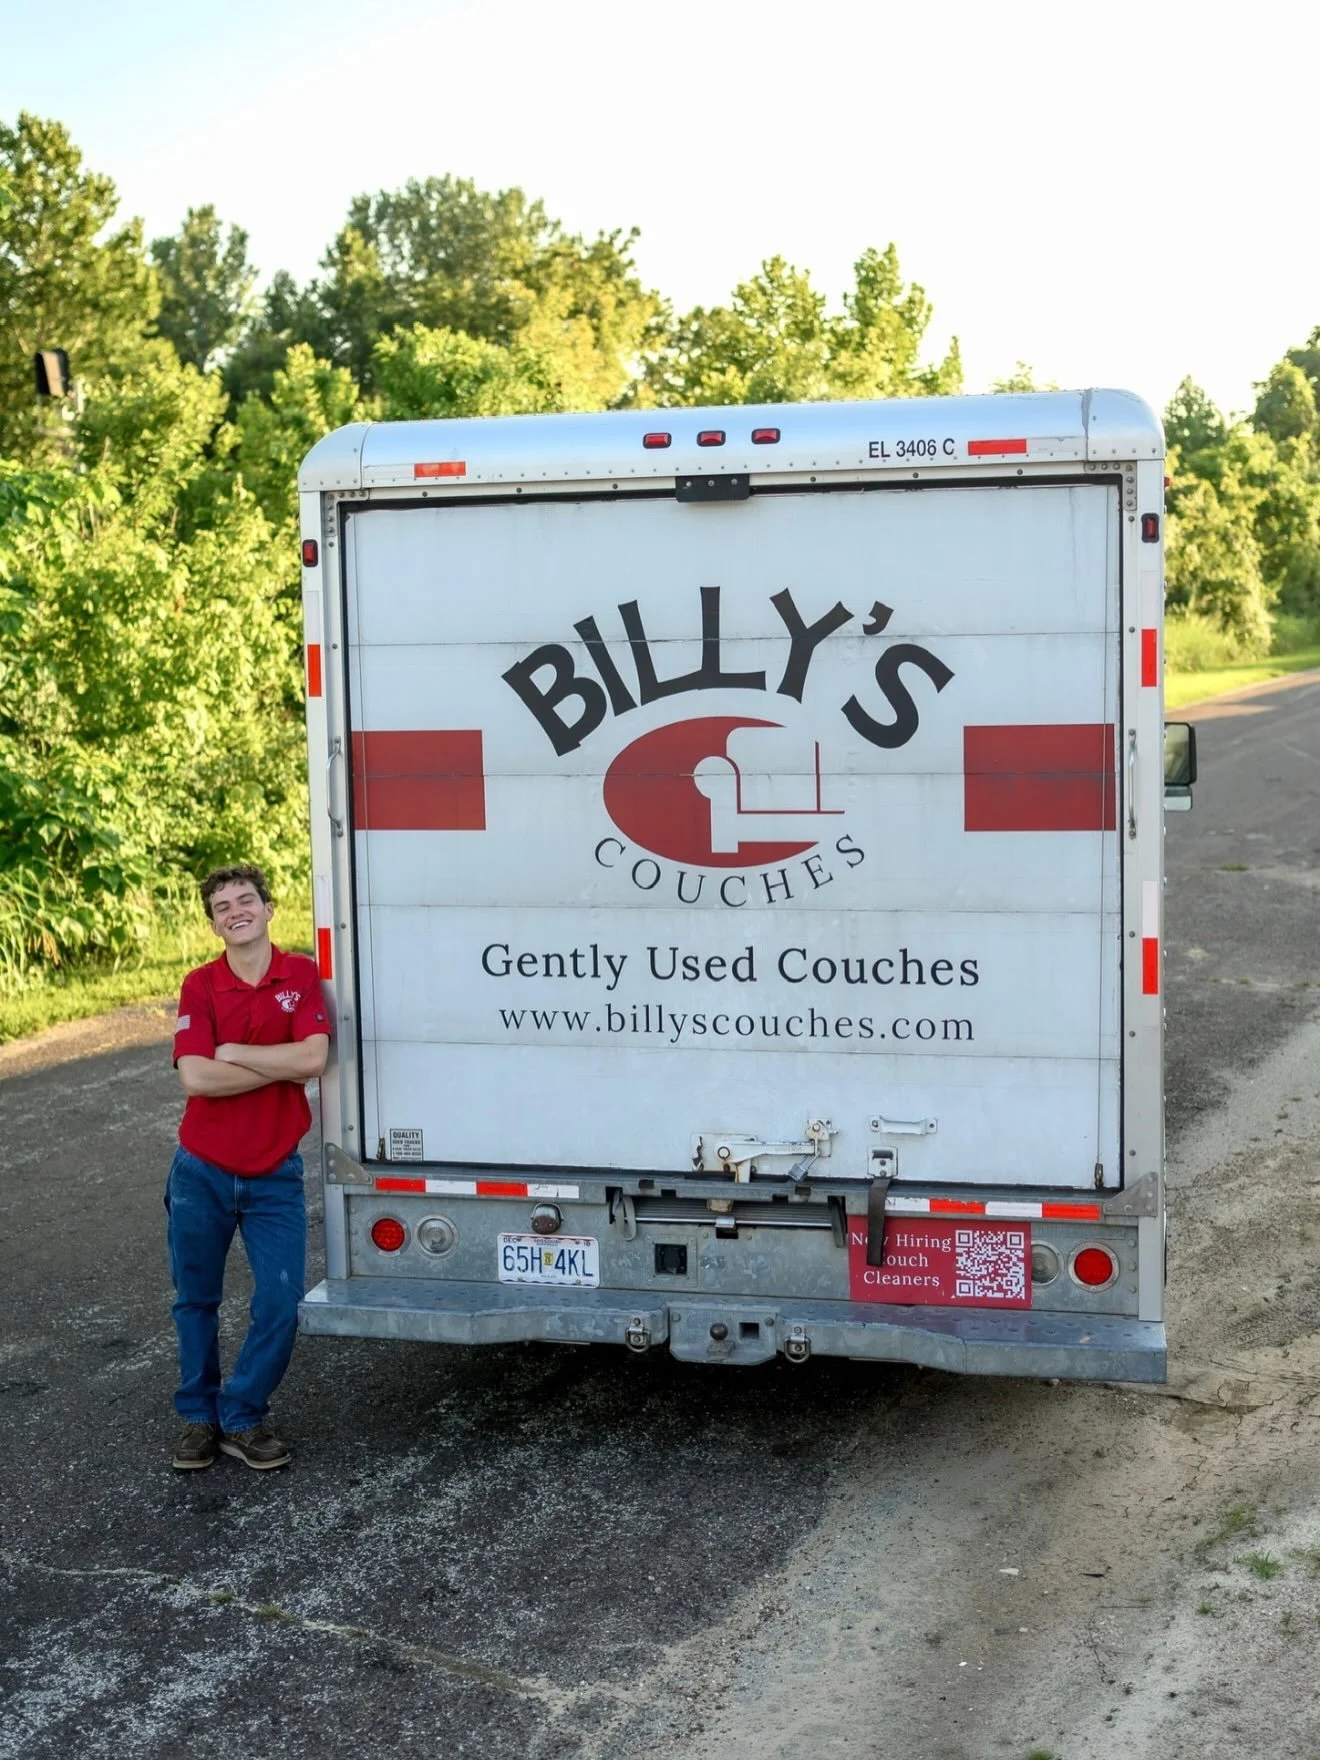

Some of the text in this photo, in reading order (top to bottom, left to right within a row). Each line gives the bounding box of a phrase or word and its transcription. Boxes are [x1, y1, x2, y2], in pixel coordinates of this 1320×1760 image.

[868, 438, 955, 458] EL 3406 C
[501, 585, 956, 757] BILLY'S
[594, 833, 865, 908] COUCHES
[481, 943, 980, 991] Gently Used Couches
[499, 1003, 975, 1043] www.billyscouches.com
[392, 1131, 420, 1139] QUALITY
[896, 1233, 952, 1253] Hiring
[503, 1245, 594, 1277] 65H 4KL
[881, 1252, 929, 1268] ouch
[863, 1270, 940, 1288] Cleaners
